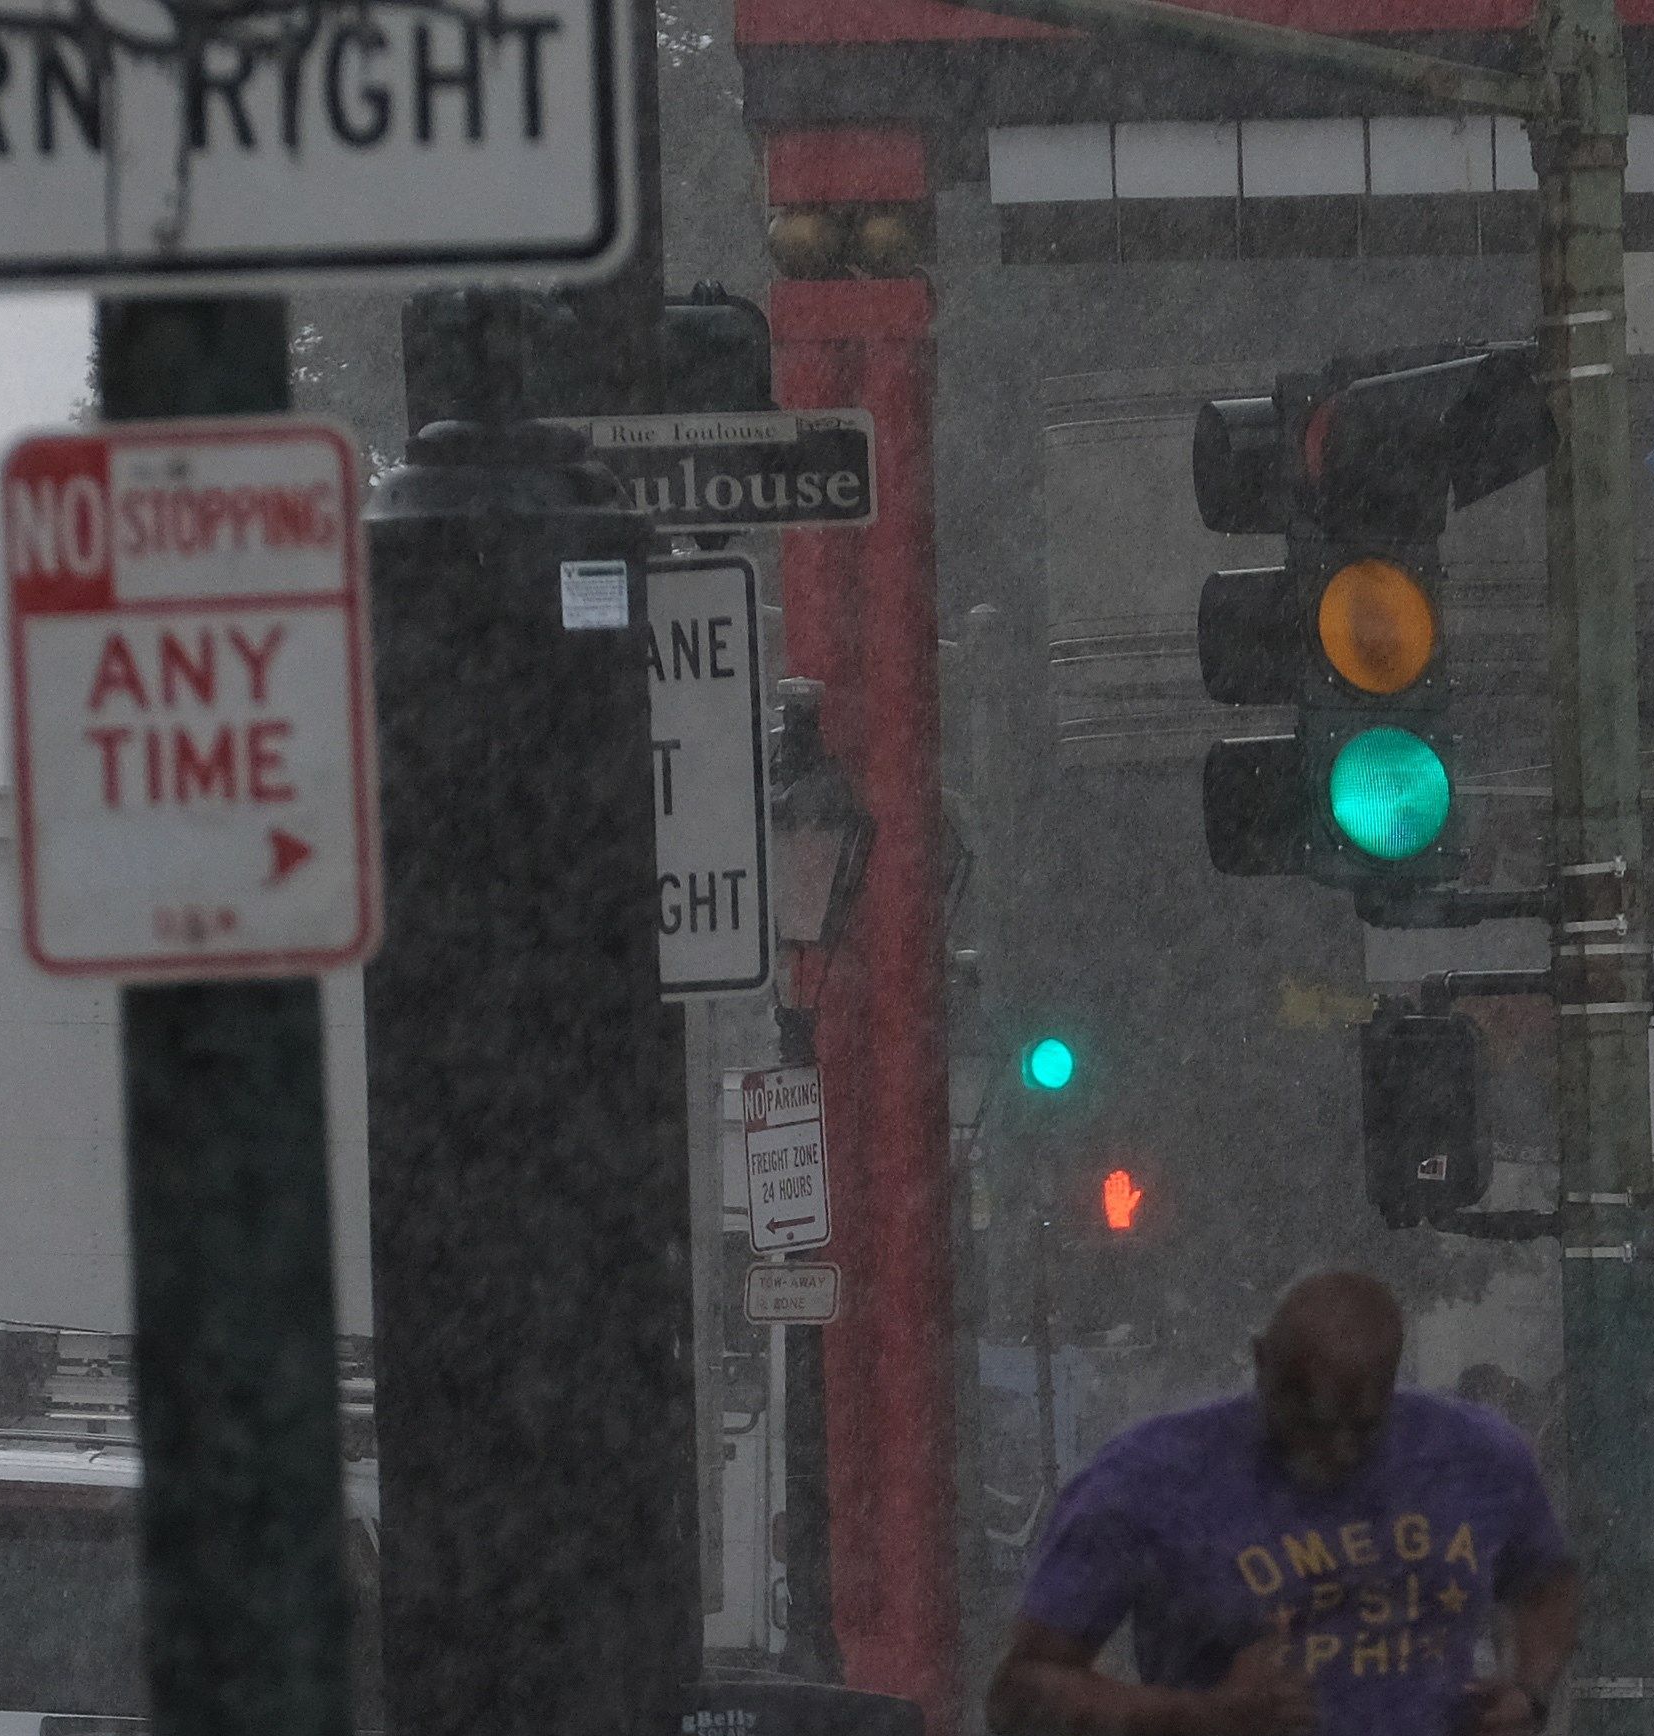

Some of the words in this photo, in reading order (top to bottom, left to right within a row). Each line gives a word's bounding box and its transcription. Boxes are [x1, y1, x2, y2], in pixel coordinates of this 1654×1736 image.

[190, 18, 560, 155] RIGHT
[610, 424, 656, 443] Rue
[672, 421, 776, 442] Toulouse
[630, 456, 862, 512] ulouse
[13, 474, 107, 579] NO
[122, 481, 339, 556] STOPPING
[87, 622, 286, 710] ANY
[647, 616, 735, 682] ANE
[85, 721, 296, 808] TIME
[660, 870, 747, 935] GHT
[746, 1086, 766, 1121] NO
[767, 1083, 818, 1112] PARKING
[751, 1147, 789, 1175] FREIGHT
[794, 1142, 819, 1169] ZONE
[762, 1181, 775, 1204] 24
[779, 1174, 813, 1200] HOURS
[1236, 1512, 1480, 1597] OMEGA
[1311, 1572, 1420, 1626] PSI
[1304, 1630, 1412, 1678] PHI
